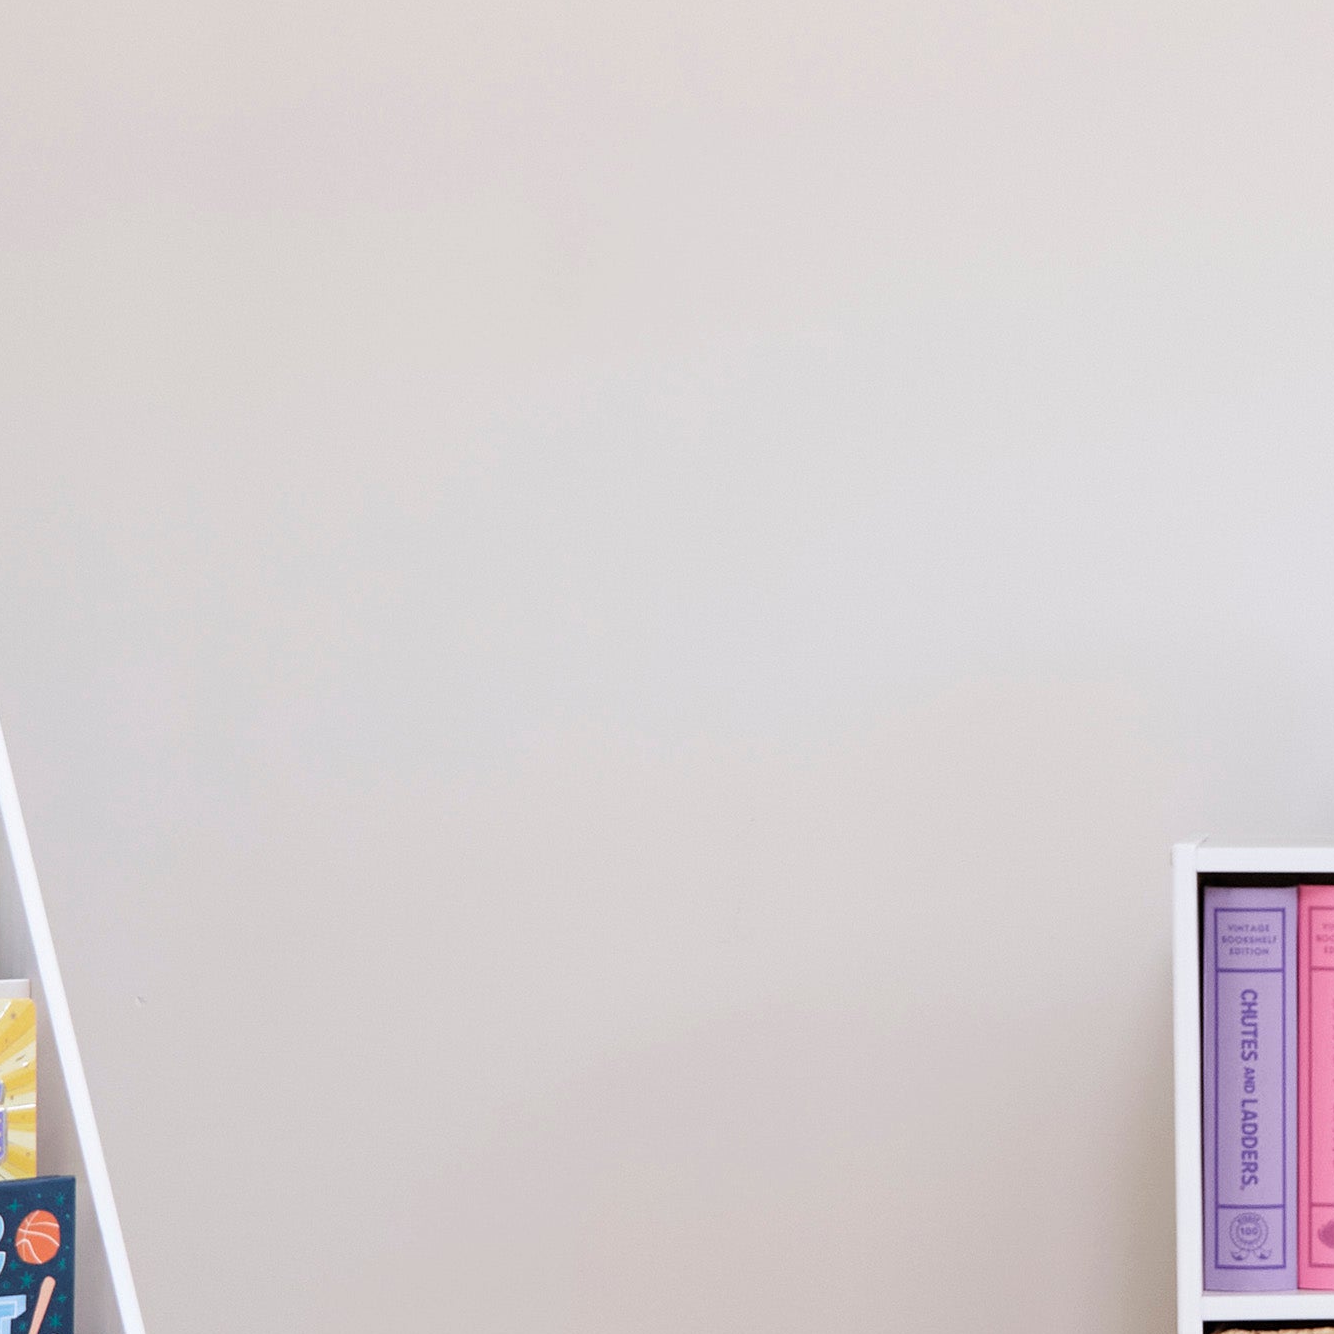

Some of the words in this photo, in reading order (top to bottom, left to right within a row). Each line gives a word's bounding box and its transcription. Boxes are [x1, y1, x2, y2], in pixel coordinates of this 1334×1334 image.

[1228, 924, 1270, 932] VINTAGE
[1228, 947, 1270, 956] EDITION
[1240, 988, 1259, 1062] CHUTES
[1243, 1066, 1256, 1095] AND
[1240, 1097, 1259, 1187] LADDERS
